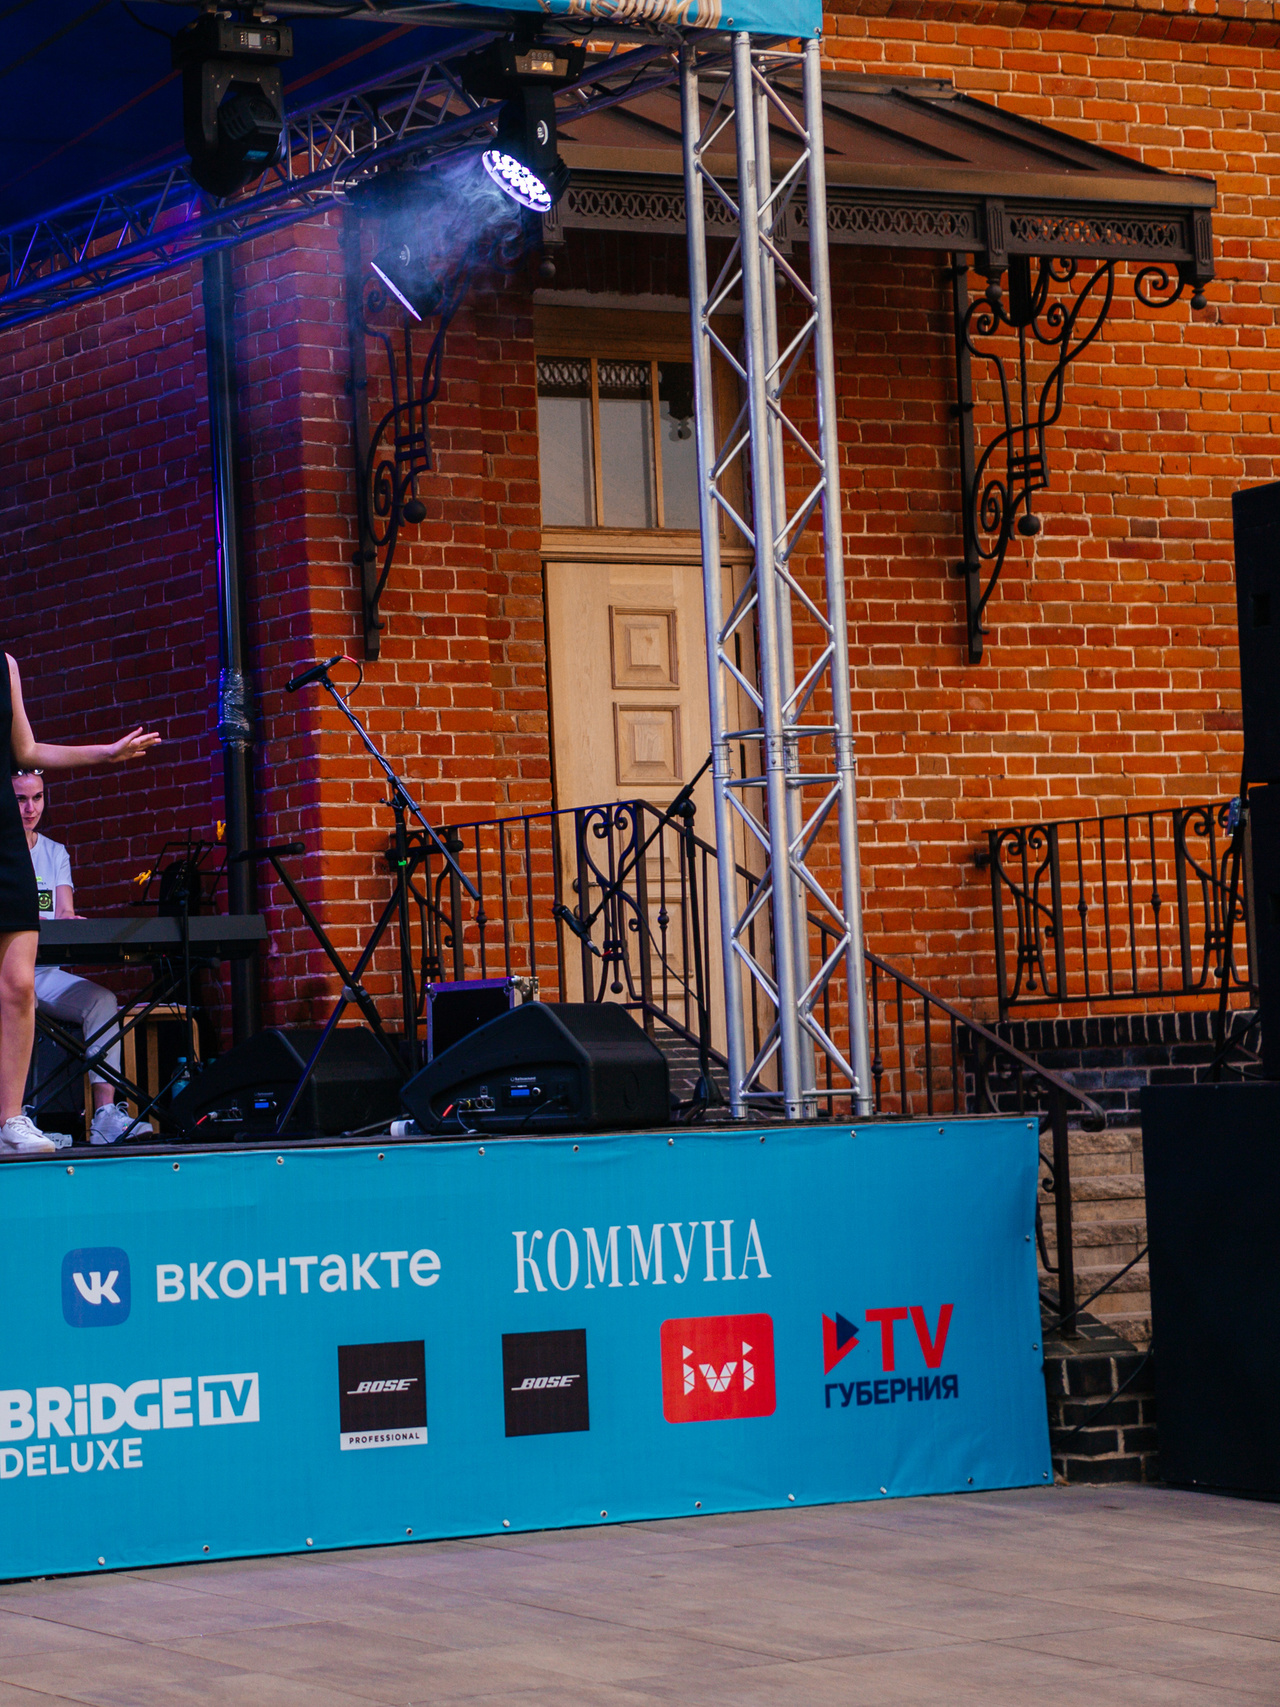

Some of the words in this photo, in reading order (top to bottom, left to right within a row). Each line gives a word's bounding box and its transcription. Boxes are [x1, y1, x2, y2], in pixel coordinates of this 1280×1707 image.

[511, 1218, 772, 1294] КОММУНА
[865, 1304, 955, 1372] TV
[201, 1376, 256, 1421] TV
[346, 1378, 418, 1395] BOSE
[511, 1374, 580, 1391] BOSE
[824, 1374, 959, 1409] ГУБЕРНИЯ
[348, 1432, 421, 1444] PROFESSIONAL
[0, 1438, 144, 1479] DELUXE
